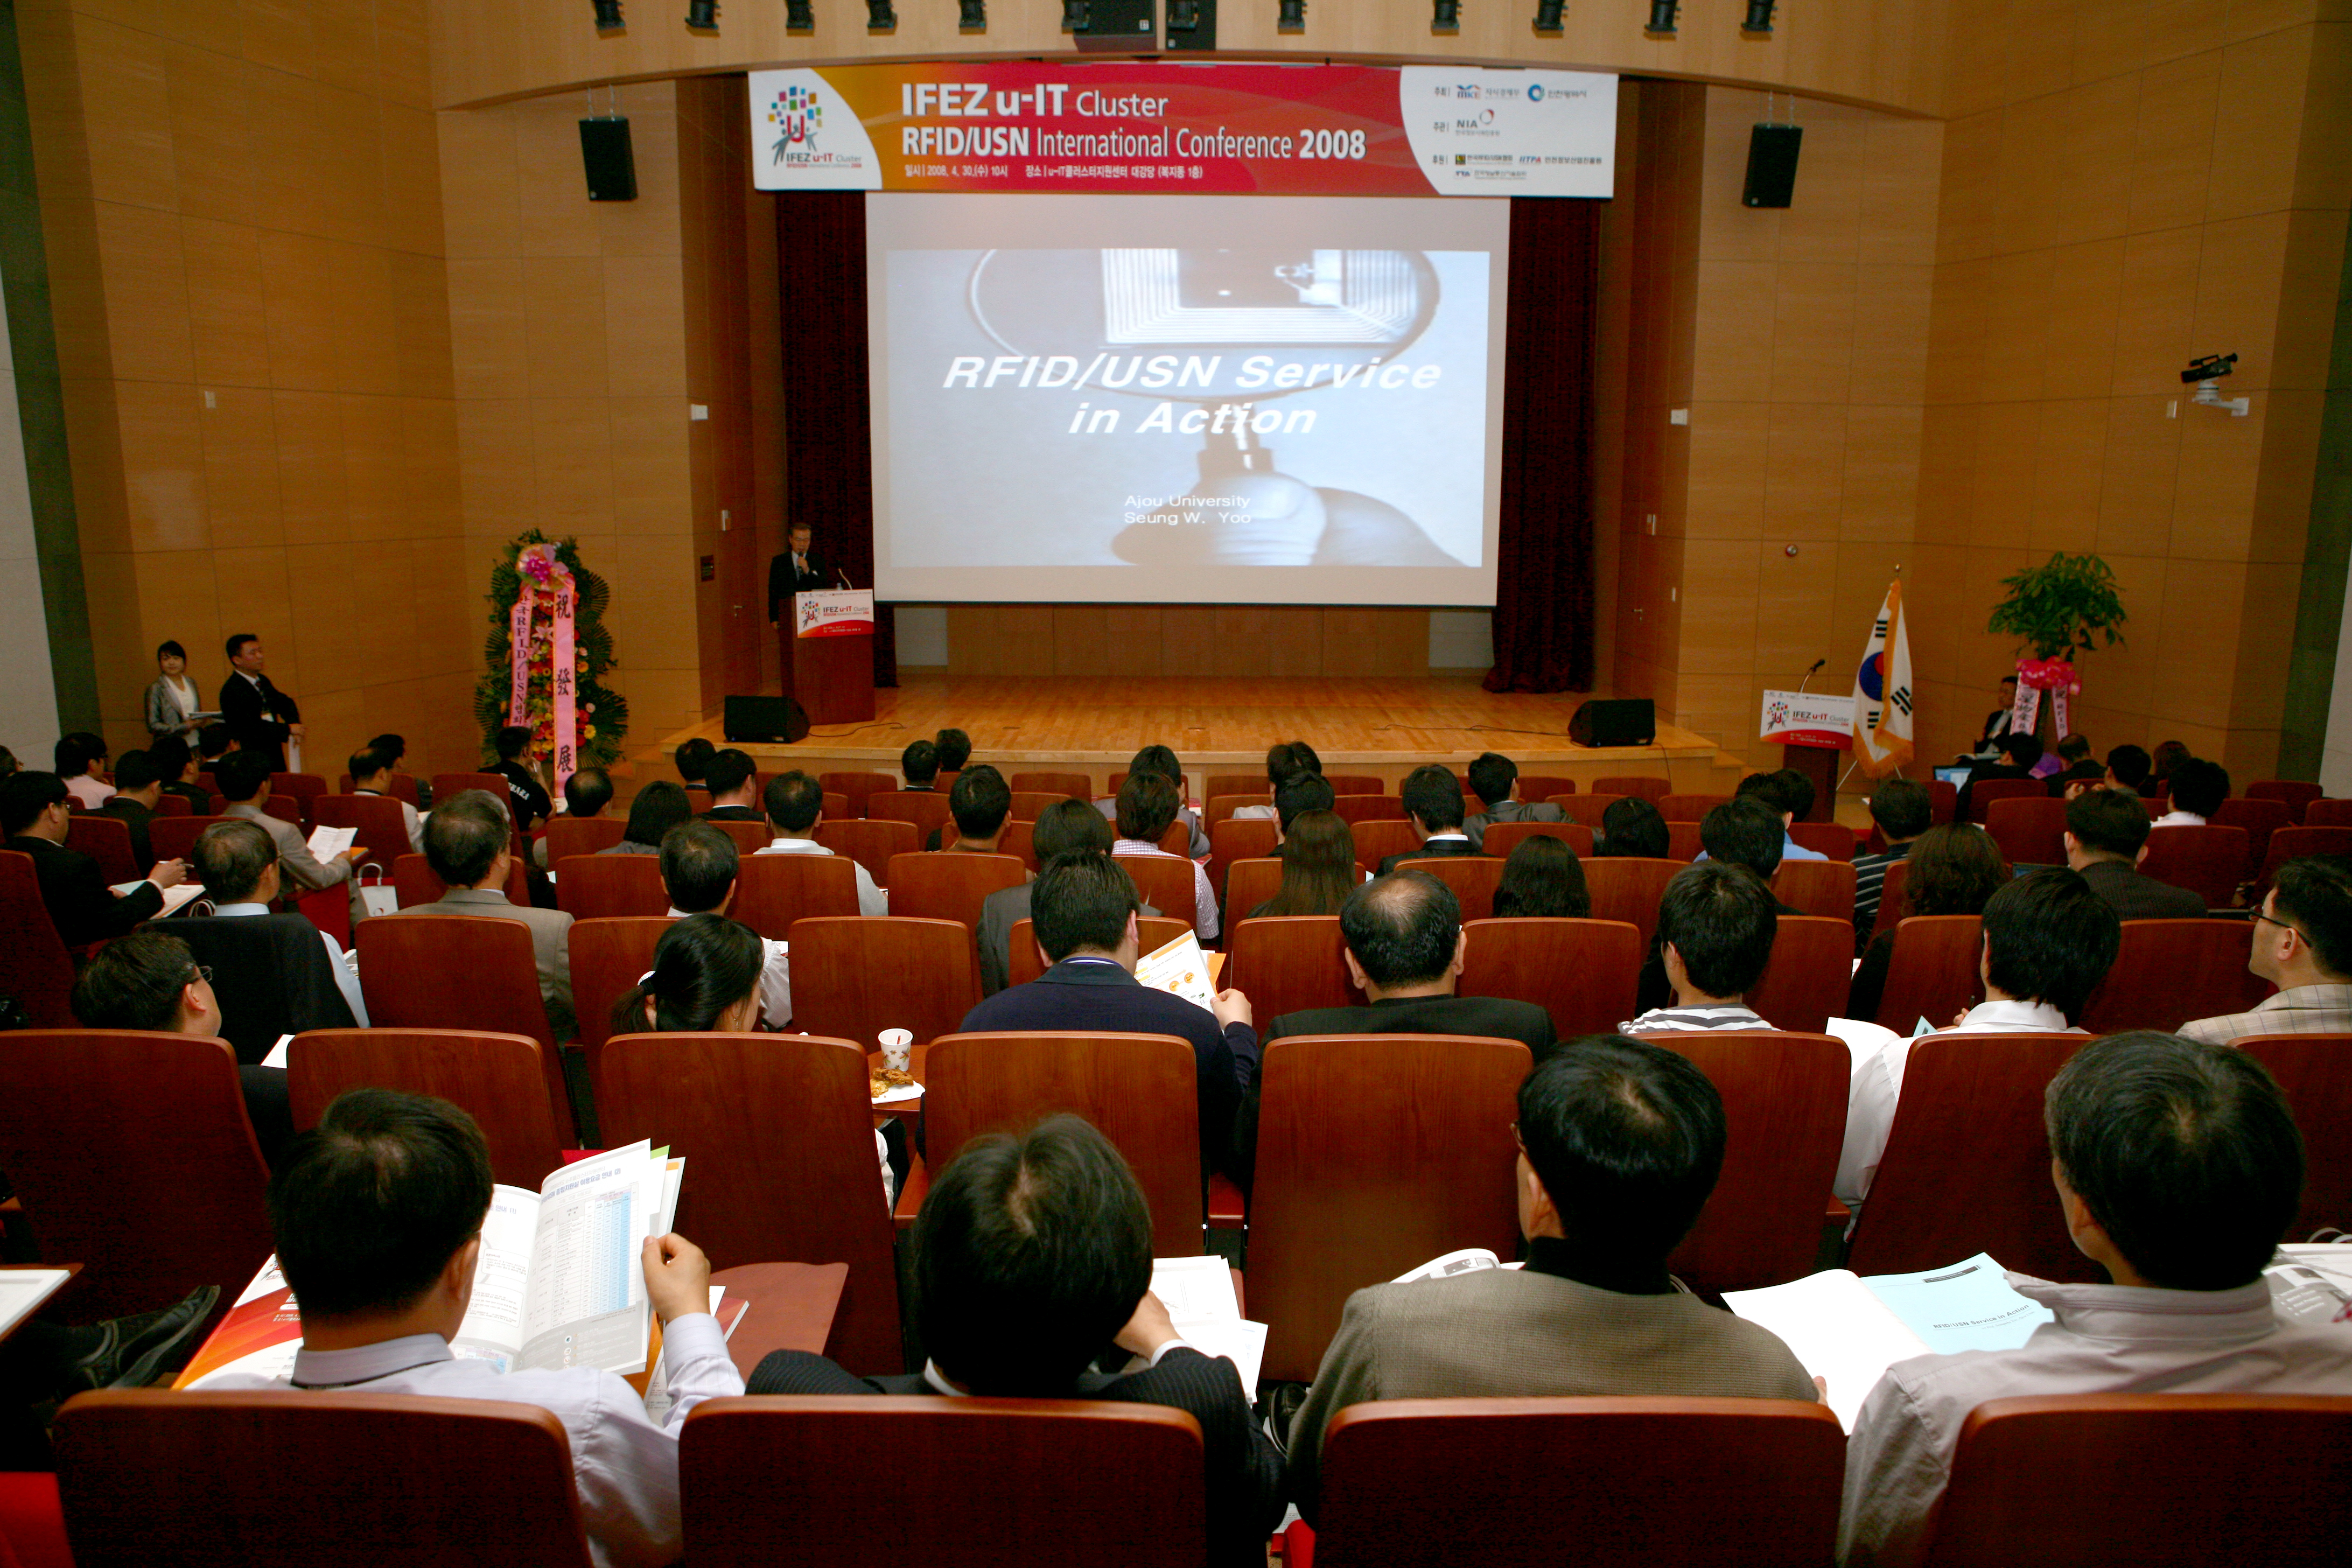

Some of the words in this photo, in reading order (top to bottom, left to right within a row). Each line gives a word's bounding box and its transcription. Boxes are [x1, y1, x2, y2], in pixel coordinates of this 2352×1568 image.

[902, 83, 989, 117] IFEZ
[996, 83, 1069, 117] u-IT
[1077, 90, 1169, 117] Cluster
[1457, 120, 1478, 129] NIA
[903, 126, 1029, 156] RFID/USN
[1037, 127, 1169, 157] International
[1177, 127, 1292, 158] Conference
[1299, 129, 1366, 159] 2008
[787, 153, 810, 162] IFEZ
[943, 352, 1219, 391] RFID/USN
[1235, 354, 1442, 389] Service
[1068, 403, 1120, 434] in
[1135, 401, 1318, 434] Action
[1124, 494, 1164, 510] Ajou
[1168, 494, 1251, 511] University
[1124, 511, 1178, 526] Seung
[1183, 512, 1207, 523] W.
[1219, 511, 1252, 523] Yoo
[1793, 710, 1811, 719] IFEZ
[1812, 713, 1828, 721] u-IT
[1933, 1321, 1970, 1329] RFID/USN
[1970, 1317, 1997, 1325] Service
[2006, 1304, 2029, 1317] Action
